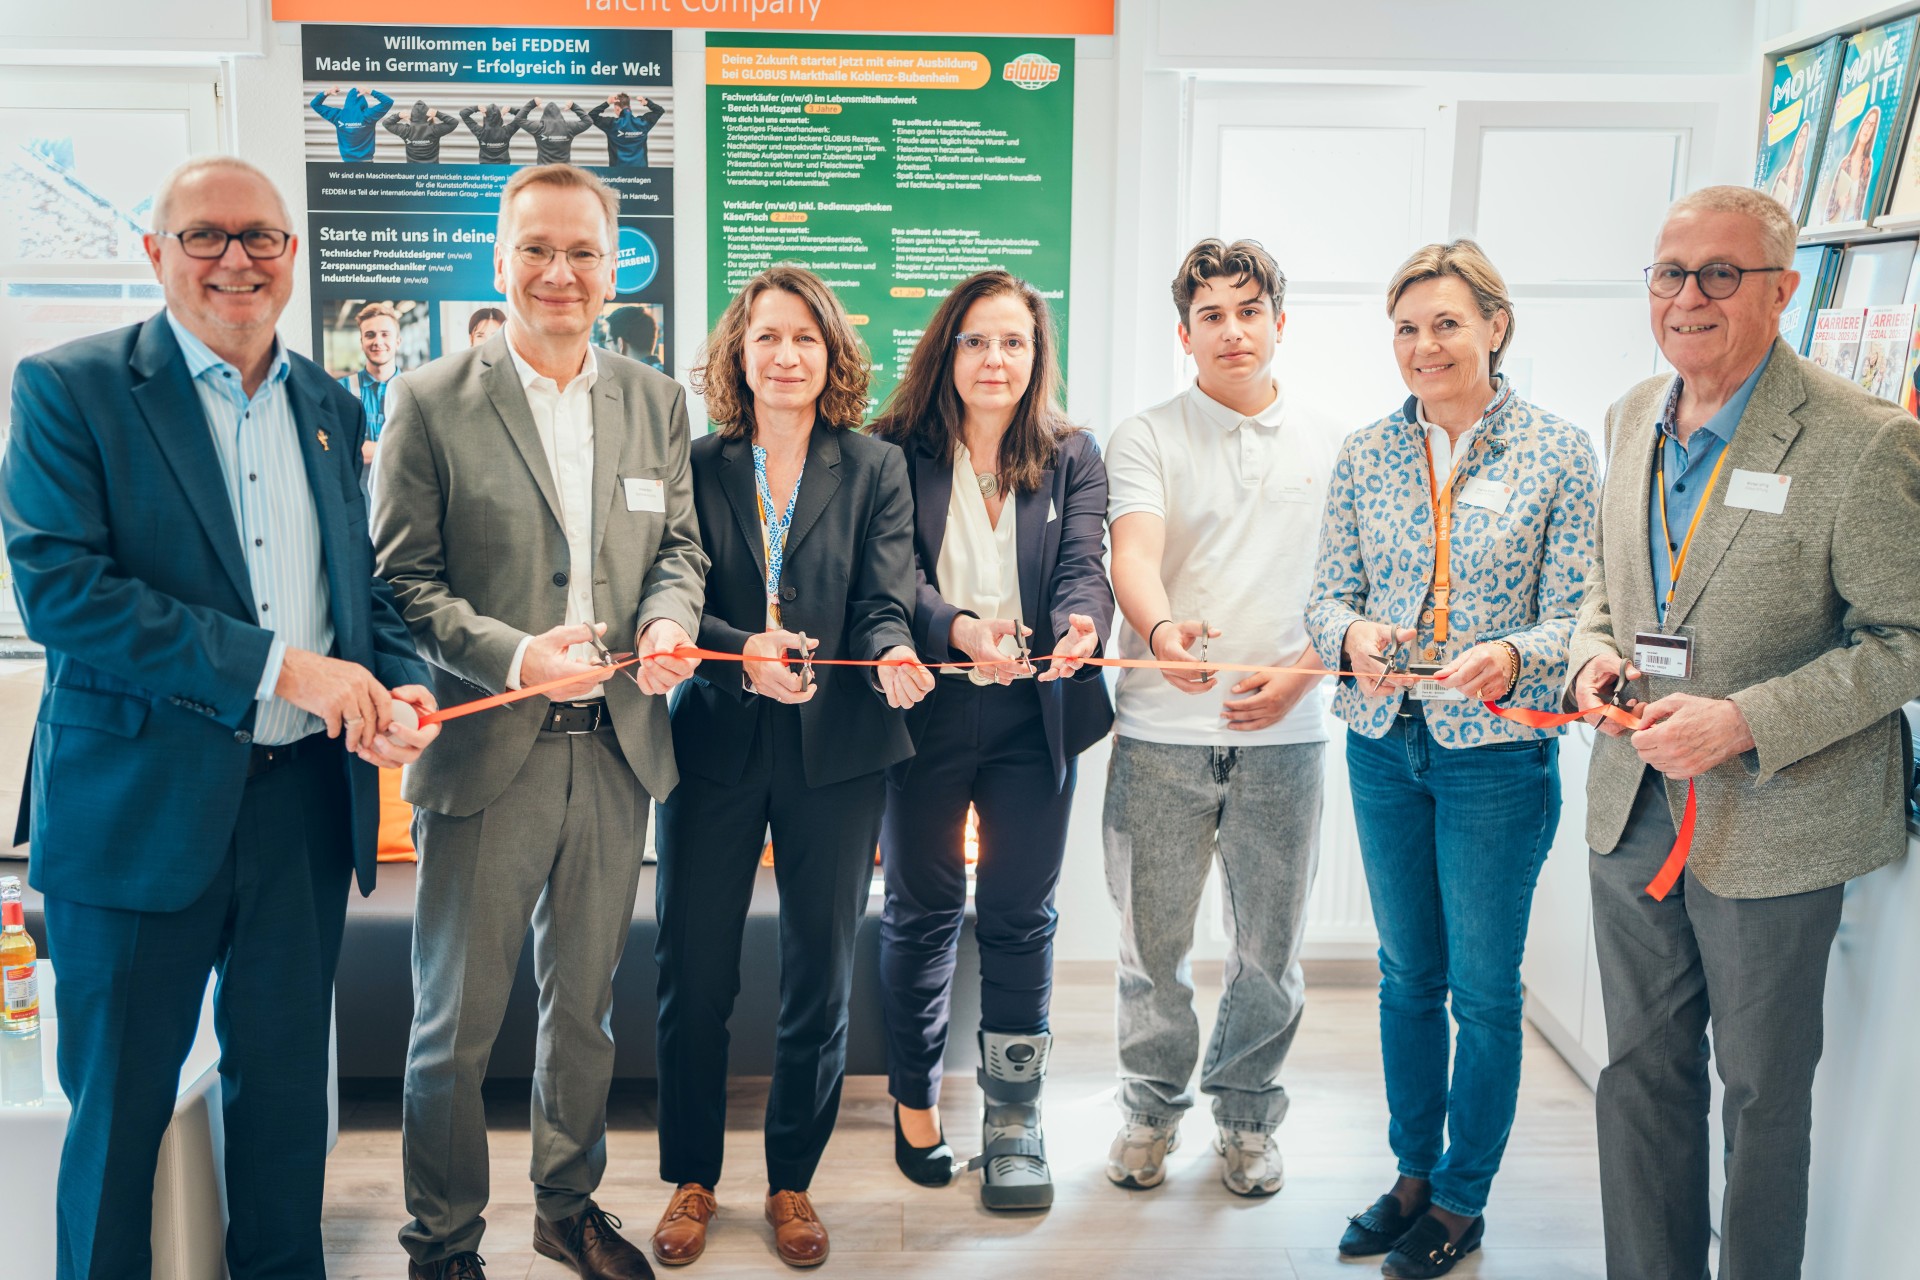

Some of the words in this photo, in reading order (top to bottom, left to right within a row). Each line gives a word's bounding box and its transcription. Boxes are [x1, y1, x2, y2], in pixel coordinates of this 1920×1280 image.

[384, 36, 486, 51] Willkommen
[492, 38, 516, 52] bei
[522, 38, 590, 52] FEDDEM
[315, 57, 360, 71] Made
[365, 58, 380, 71] in
[385, 58, 458, 76] Germany
[477, 59, 565, 77] Erfolgreich
[571, 61, 585, 74] in
[591, 61, 618, 75] der
[622, 62, 660, 76] Welt
[722, 54, 752, 65] Deine
[756, 55, 798, 66] Zukunft
[800, 55, 836, 67] startet
[839, 56, 863, 70] jetzt
[865, 56, 884, 67] mit
[886, 57, 913, 68] einer
[916, 57, 977, 71] Ausbildung
[1841, 33, 1901, 95] MOVE
[722, 69, 738, 79] bei
[741, 69, 787, 80] GLOBUS
[790, 70, 847, 81] Markthalle
[850, 71, 958, 83] Koblenz-Bubenheim
[1772, 54, 1825, 111] MOVE
[1870, 64, 1904, 105] IT!
[722, 93, 779, 101] Fachverkäufer
[780, 94, 813, 103] (m/w/d)
[826, 95, 917, 104] Lebensmittelhandwerk
[1803, 80, 1825, 119] IT!
[760, 105, 801, 114] Metzgerei
[727, 125, 765, 133] Großartiges
[727, 134, 782, 142] Zerlegetechniken
[851, 136, 880, 144] Rezepte.
[727, 143, 767, 151] Nachhaltiger
[782, 144, 822, 152] respektvoller
[824, 144, 852, 152] Umgang
[727, 152, 760, 160] Vielfältige
[822, 153, 862, 161] Zubereitung
[481, 174, 505, 182] fertigen
[817, 171, 860, 179] hygienischen
[727, 179, 768, 187] Verarbeitung
[629, 193, 660, 202] Hamburg.
[723, 202, 762, 210] Verkäufer
[764, 202, 796, 212] (m/w/d)
[798, 202, 815, 210] inkl.
[817, 202, 892, 213] Bedienungstheken
[723, 213, 768, 221] Käse/Fisch
[320, 227, 366, 241] Starte
[371, 228, 397, 242] mit
[401, 231, 428, 242] uns
[433, 228, 447, 242] in
[452, 228, 495, 242] deine
[320, 249, 371, 258] Technischer
[373, 250, 445, 261] Produktdesigner
[447, 252, 472, 260] (m/w/d)
[616, 247, 636, 258] ETZT
[321, 262, 425, 274] Zerspanungsmechaniker
[429, 264, 453, 273] (m/w/d)
[321, 274, 401, 283] Industriekaufleute
[404, 276, 428, 285] (m/w/d)
[1817, 316, 1860, 330] KARRIERE
[1867, 329, 1887, 339] PEZIAL
